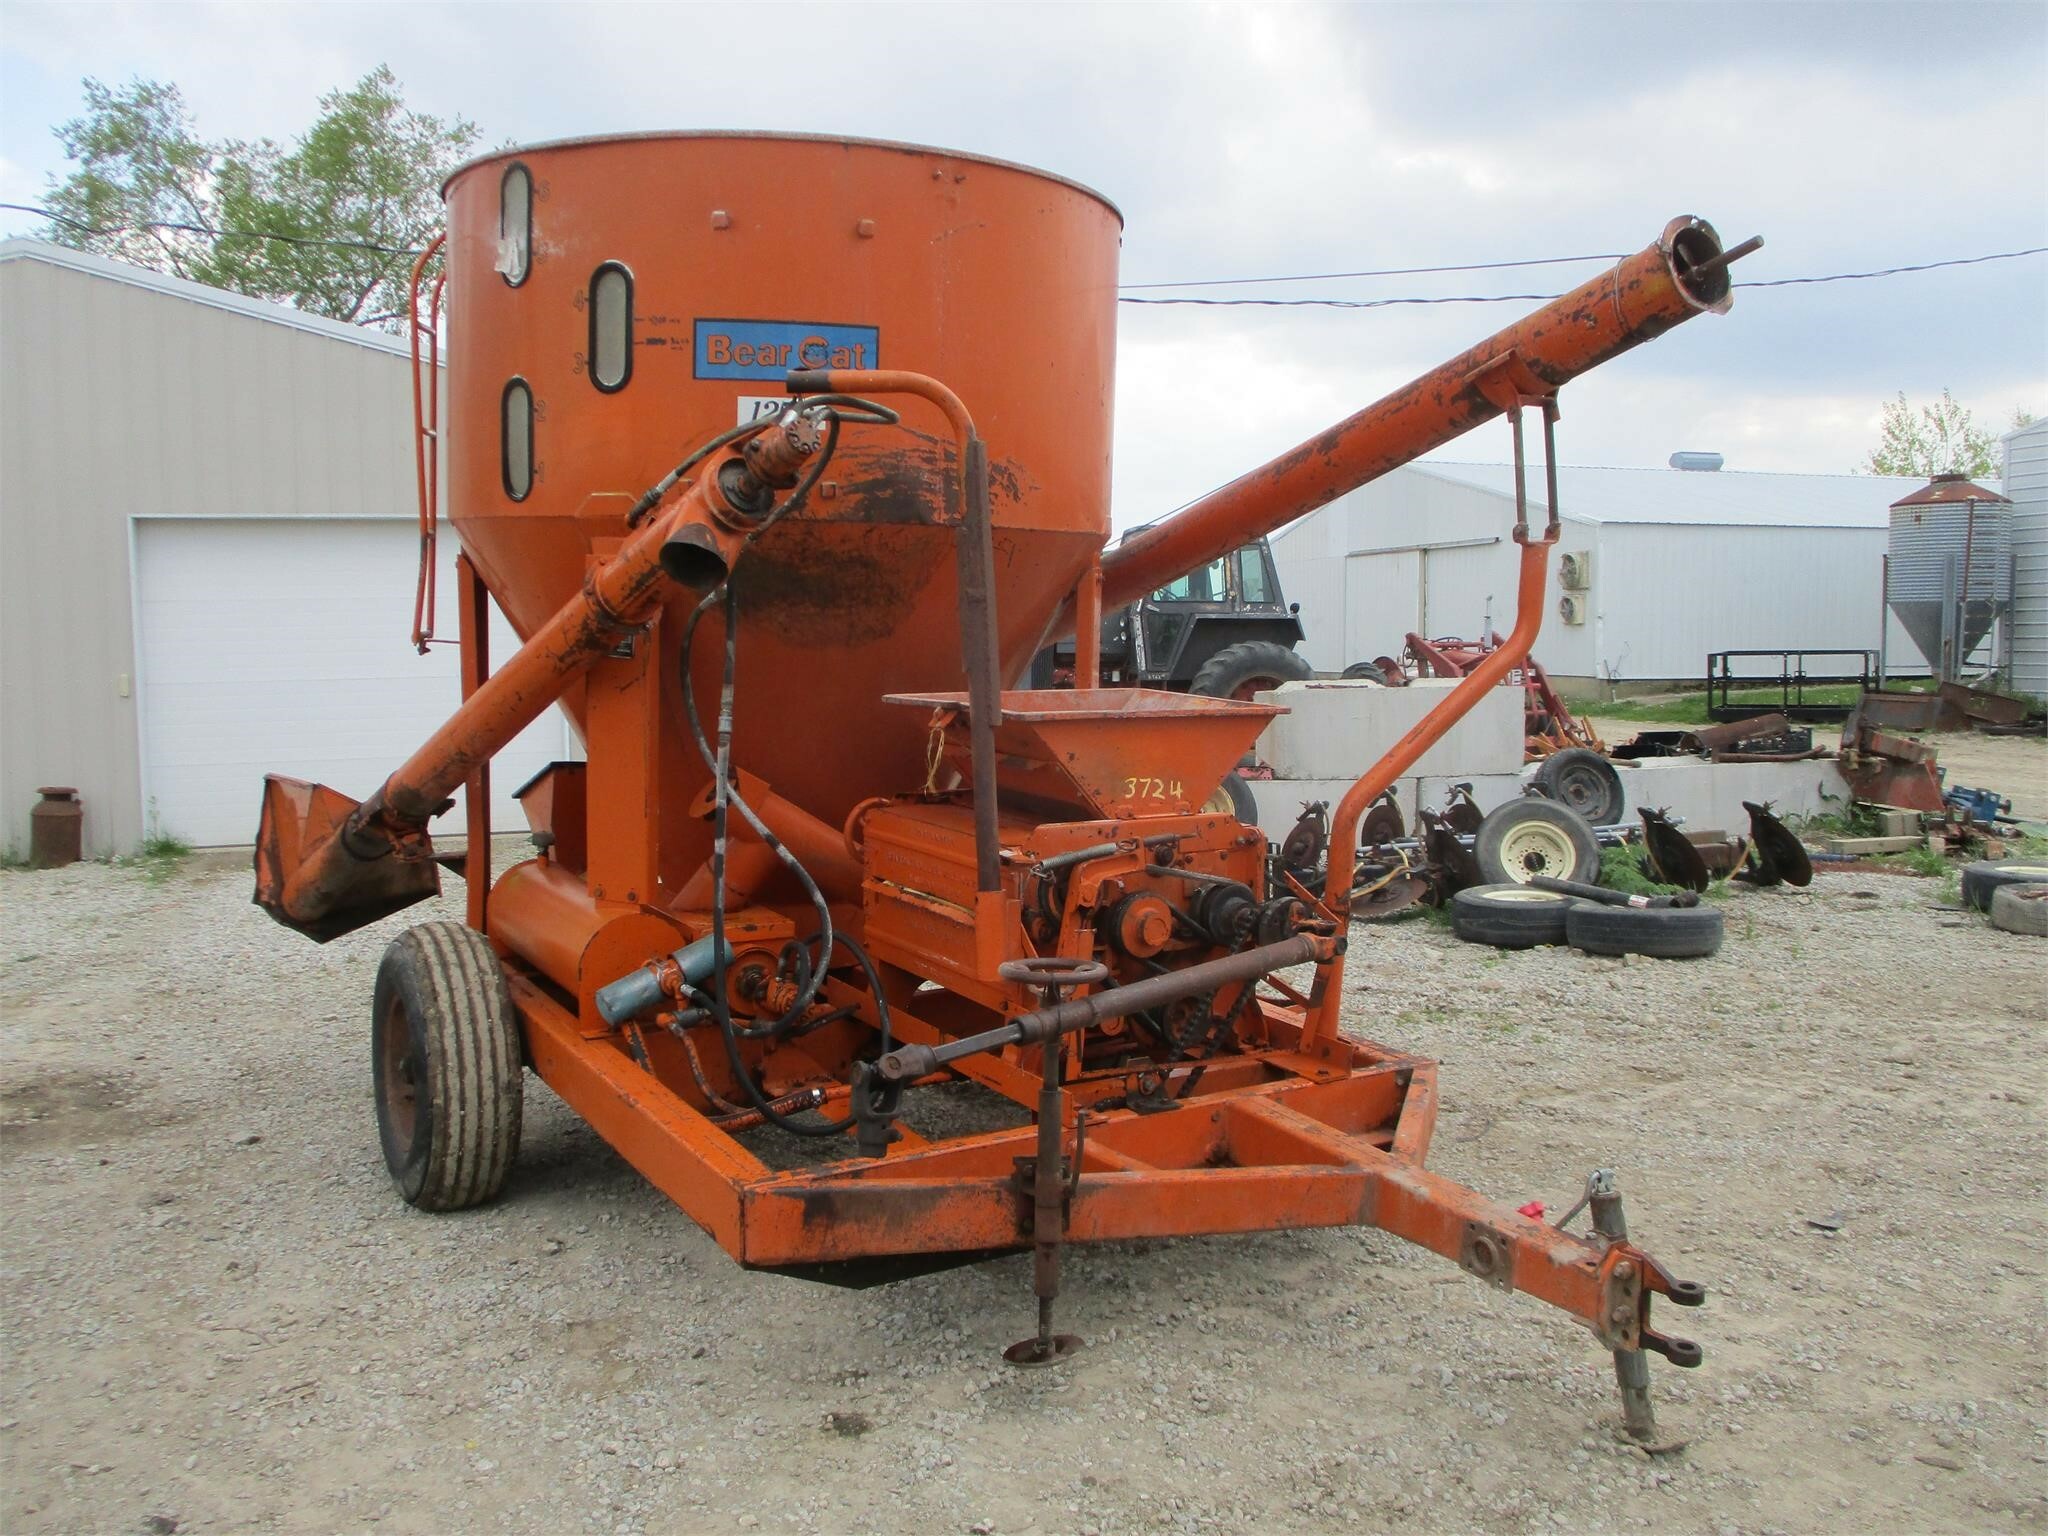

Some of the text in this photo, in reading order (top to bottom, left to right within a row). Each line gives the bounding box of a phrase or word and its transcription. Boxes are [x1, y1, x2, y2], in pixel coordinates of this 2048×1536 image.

[572, 289, 584, 312] 4
[572, 352, 584, 375] 3
[706, 334, 792, 367] Bear
[798, 335, 866, 370] Cat
[536, 400, 546, 423] 2
[1124, 777, 1184, 800] 3724
